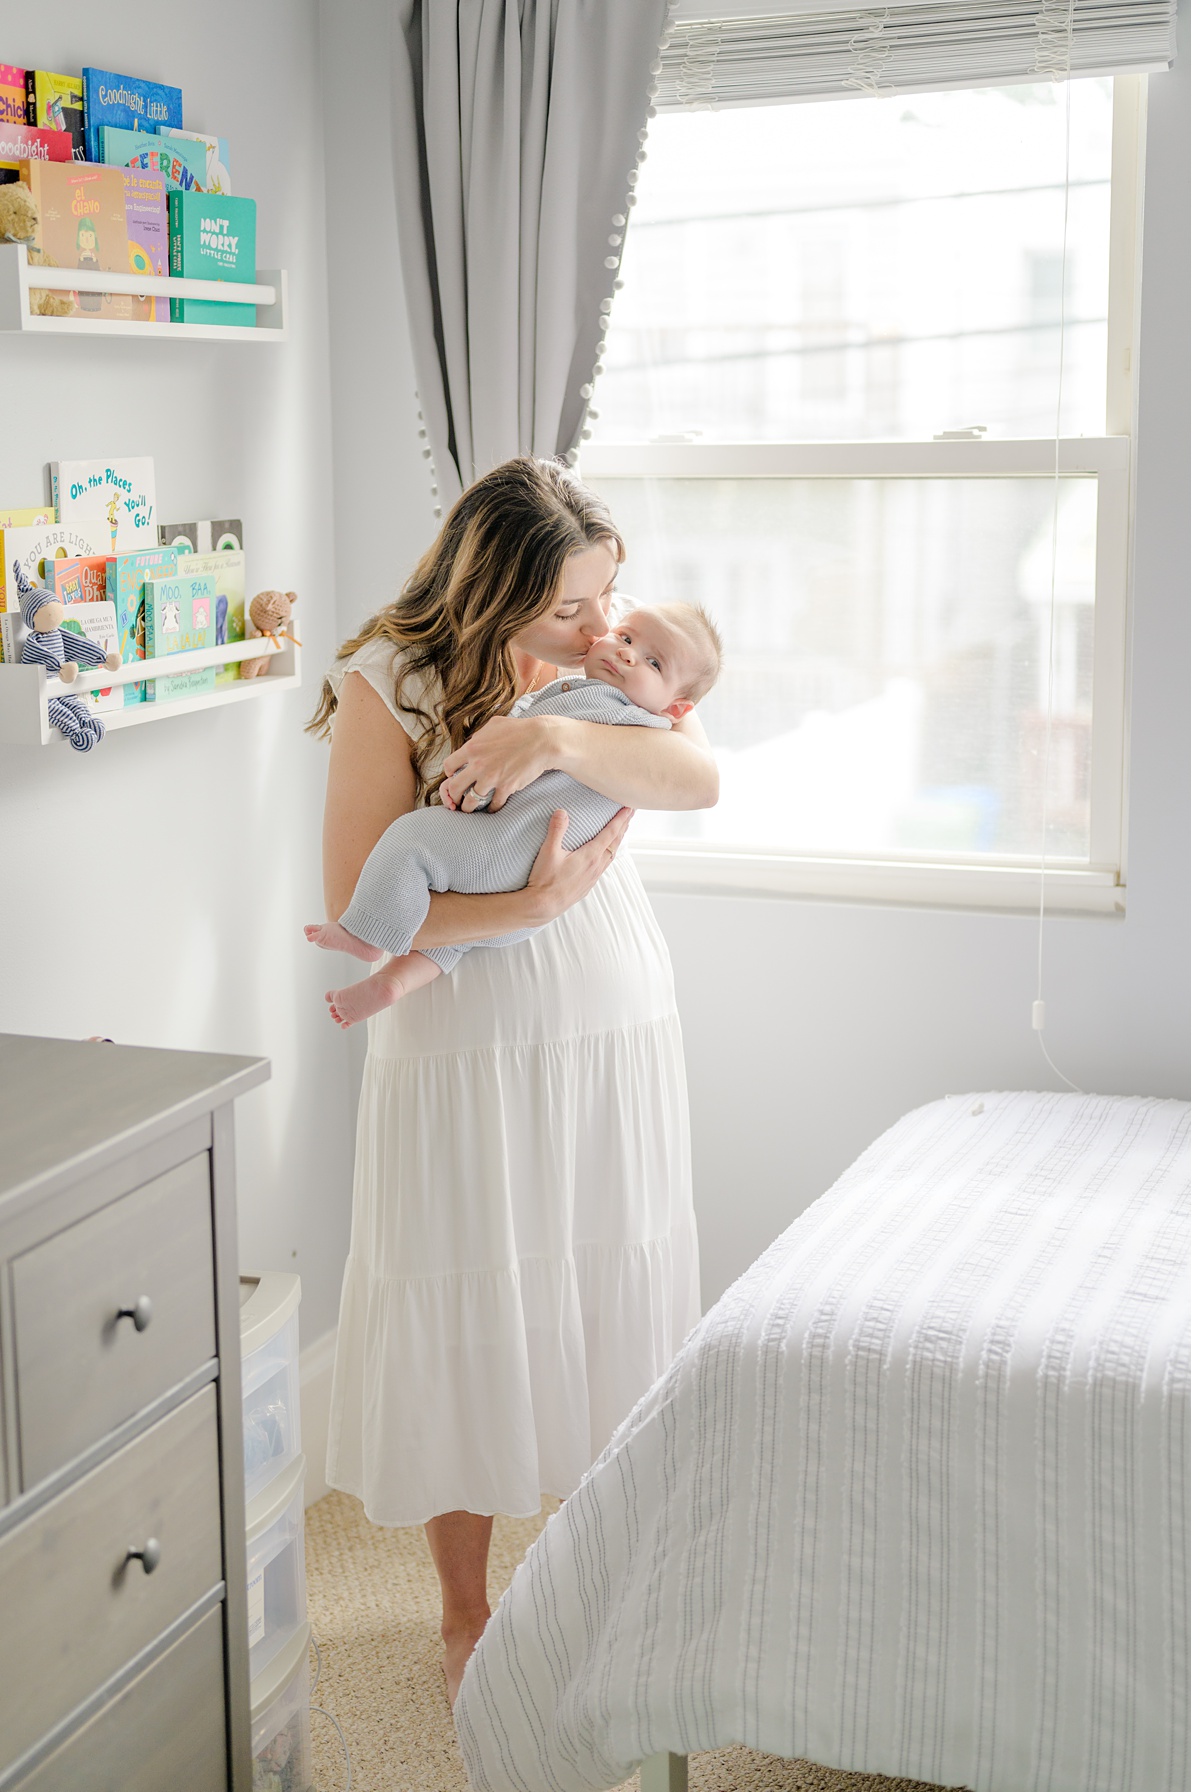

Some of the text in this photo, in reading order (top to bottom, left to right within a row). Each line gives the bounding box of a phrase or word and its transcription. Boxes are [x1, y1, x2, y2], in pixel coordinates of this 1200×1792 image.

[99, 85, 168, 121] Goodnight Little
[200, 218, 229, 235] DON'T
[200, 232, 239, 255] WORRY,
[200, 248, 222, 260] LITTLE
[70, 468, 133, 500] Oh, the Places
[123, 494, 147, 513] You'll
[134, 505, 153, 529] Go!
[23, 532, 96, 570] YOU ARE LIGH
[135, 554, 163, 568] FUTURE
[160, 584, 182, 601] MOO,
